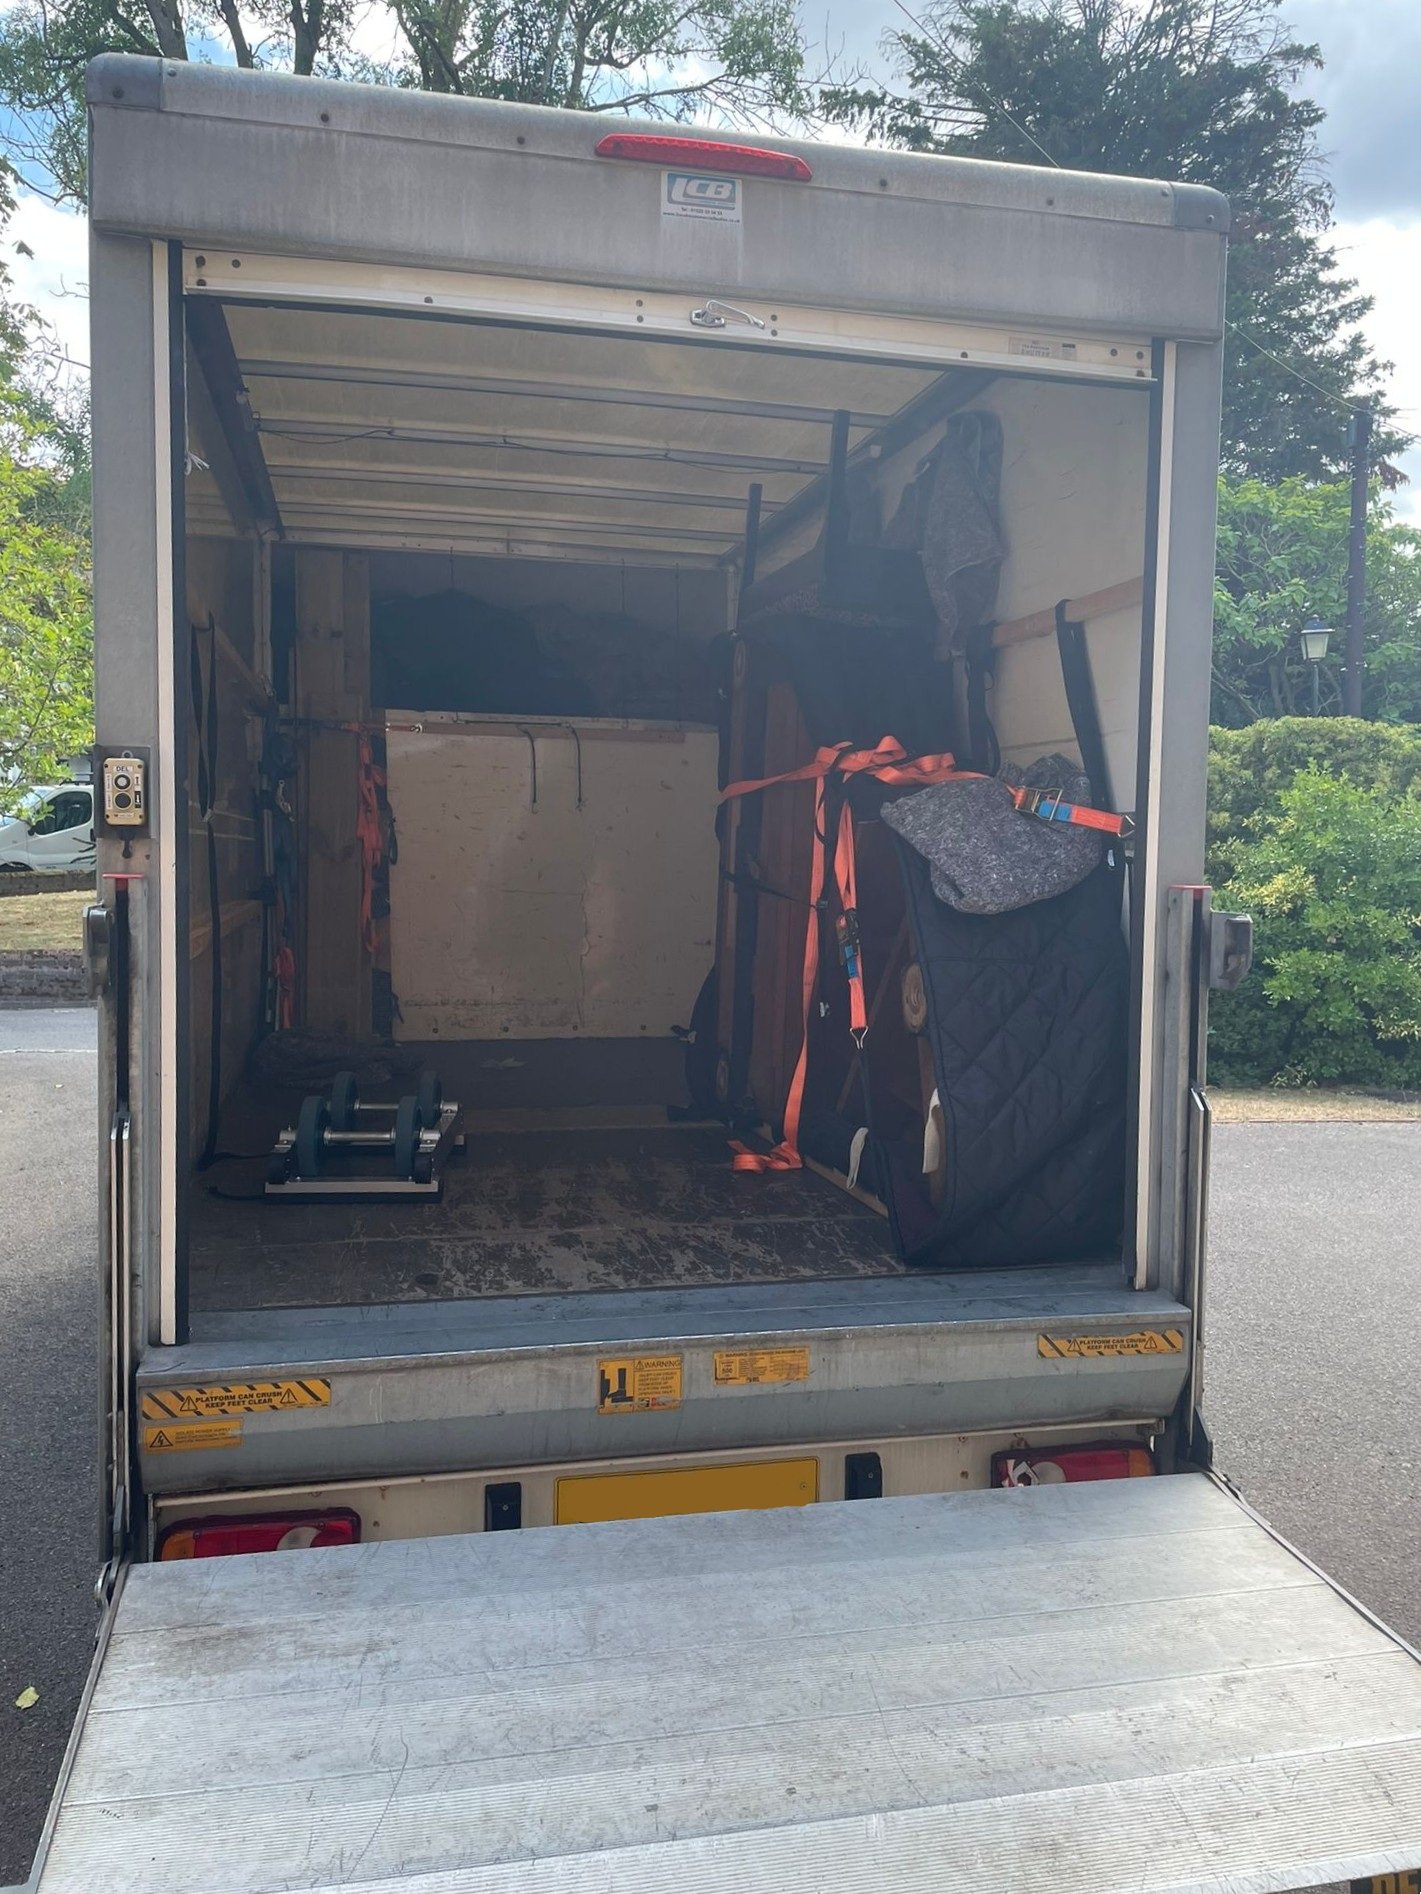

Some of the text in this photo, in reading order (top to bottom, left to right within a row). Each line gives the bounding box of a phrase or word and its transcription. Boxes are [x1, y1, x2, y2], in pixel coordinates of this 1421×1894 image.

[671, 178, 733, 202] LCB
[644, 1360, 681, 1369] WARNING
[195, 1391, 283, 1403] PLATFORM CAN CRUSH
[205, 1401, 226, 1409] KEEP
[247, 1398, 273, 1406] CLEAR
